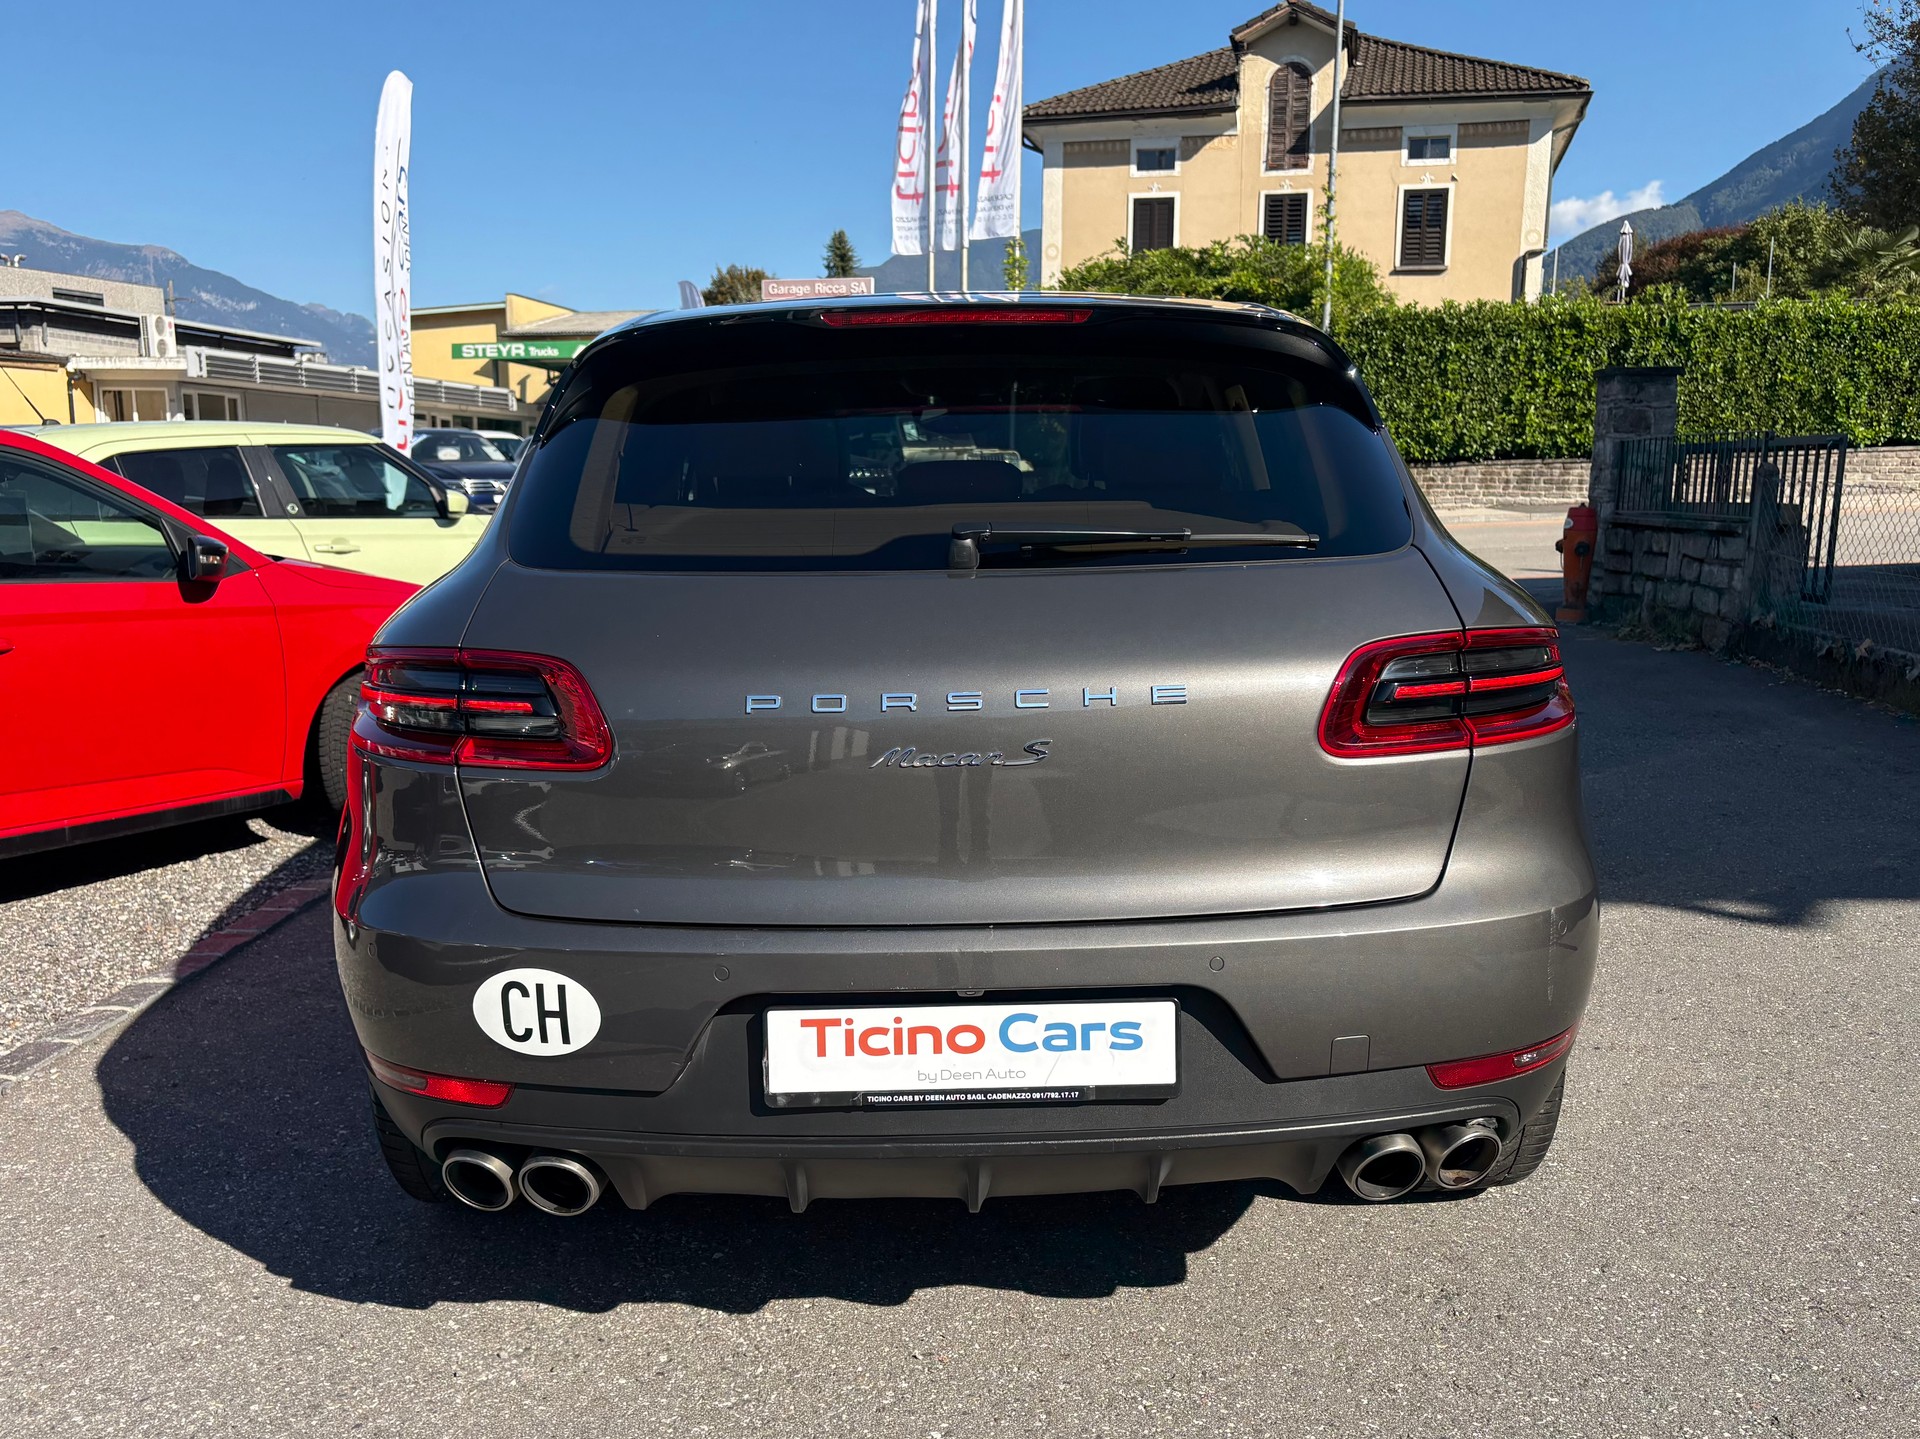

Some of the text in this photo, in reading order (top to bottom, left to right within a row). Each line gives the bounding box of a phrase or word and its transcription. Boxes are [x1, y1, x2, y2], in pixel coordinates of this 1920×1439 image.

[768, 281, 868, 297] Garage Ricca SA
[462, 344, 560, 357] STEYR Trucks
[745, 684, 1188, 715] PORSCHE
[869, 739, 1053, 768] Macan S
[501, 980, 571, 1045] CH
[800, 1012, 1144, 1058] Ticino Cars
[917, 1068, 1027, 1084] by Deen Auto
[867, 1095, 892, 1103] TICINO
[914, 1094, 924, 1102] BY
[945, 1093, 966, 1101] AUTO
[986, 1092, 1031, 1100] CADENAZZO
